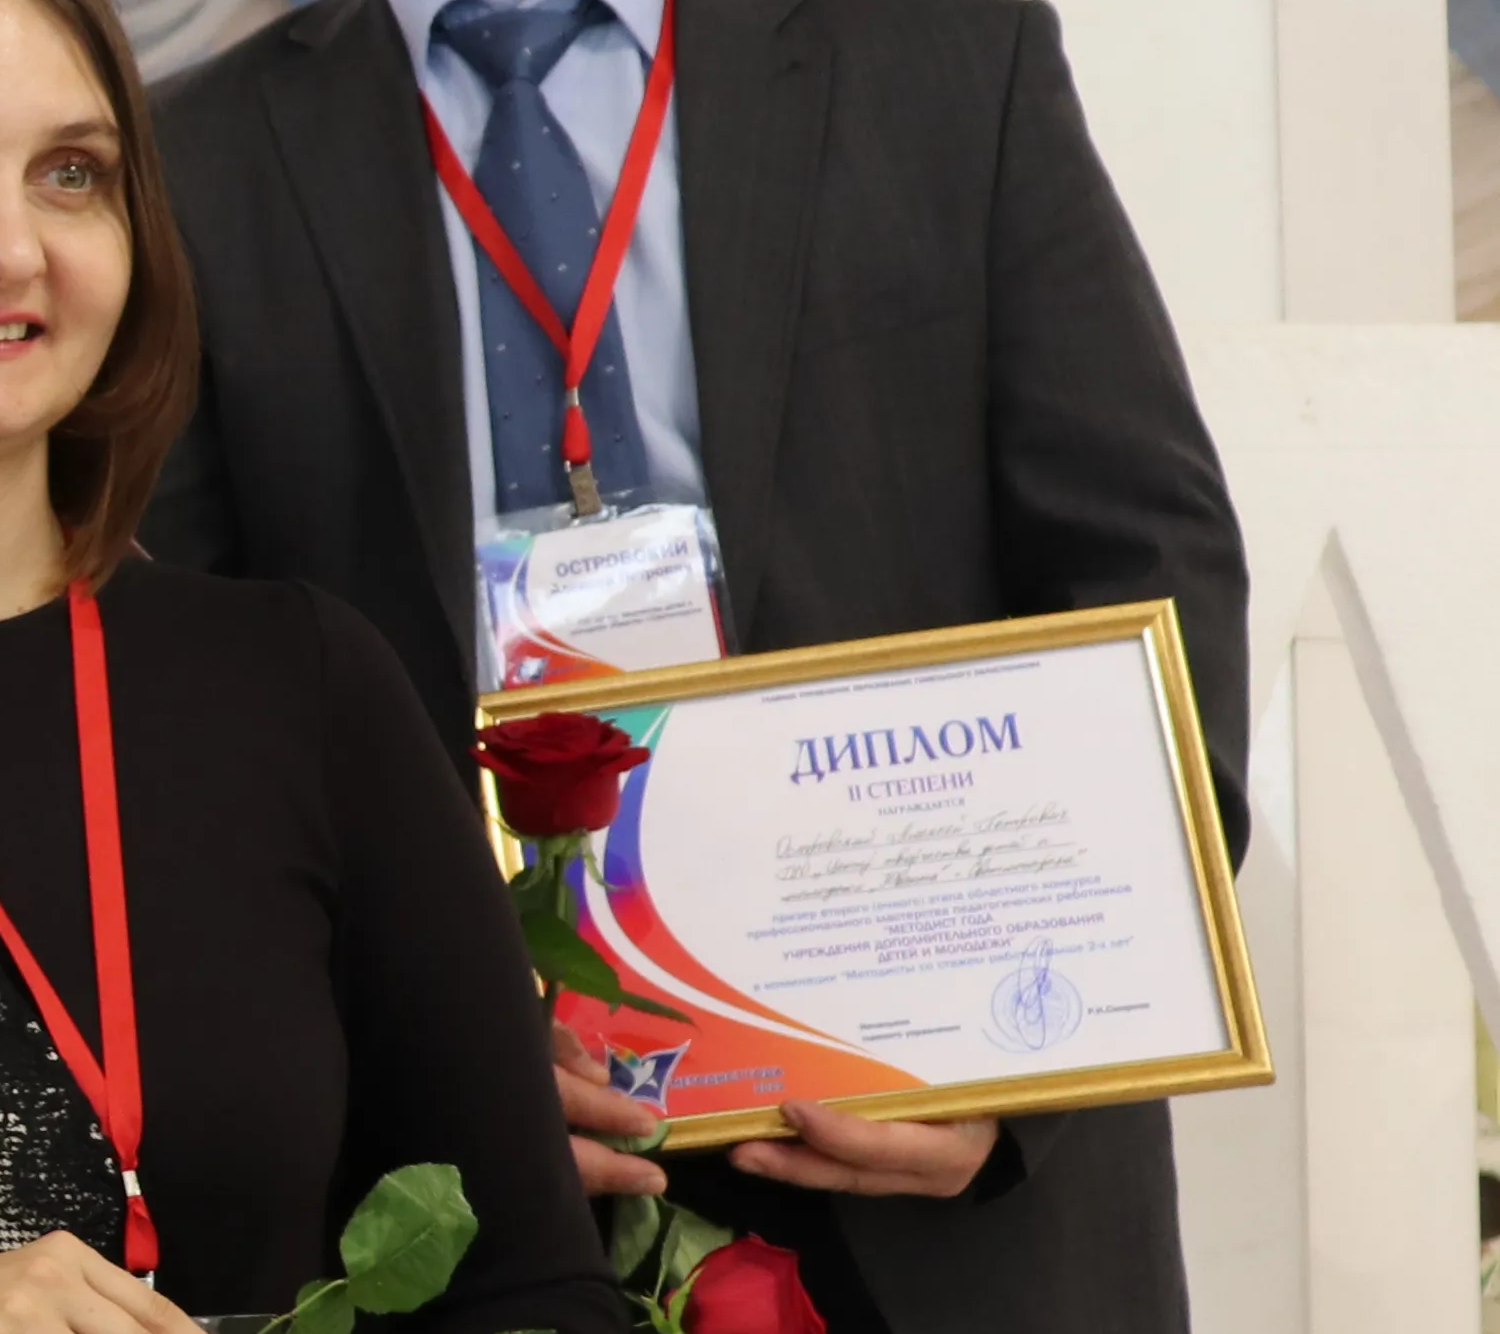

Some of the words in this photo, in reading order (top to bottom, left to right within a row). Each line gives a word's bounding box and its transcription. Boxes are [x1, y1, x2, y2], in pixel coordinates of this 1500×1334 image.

[783, 711, 1025, 785] ДИПЛОМ
[847, 784, 862, 802] II
[866, 770, 974, 800] СТЕПЕНИ
